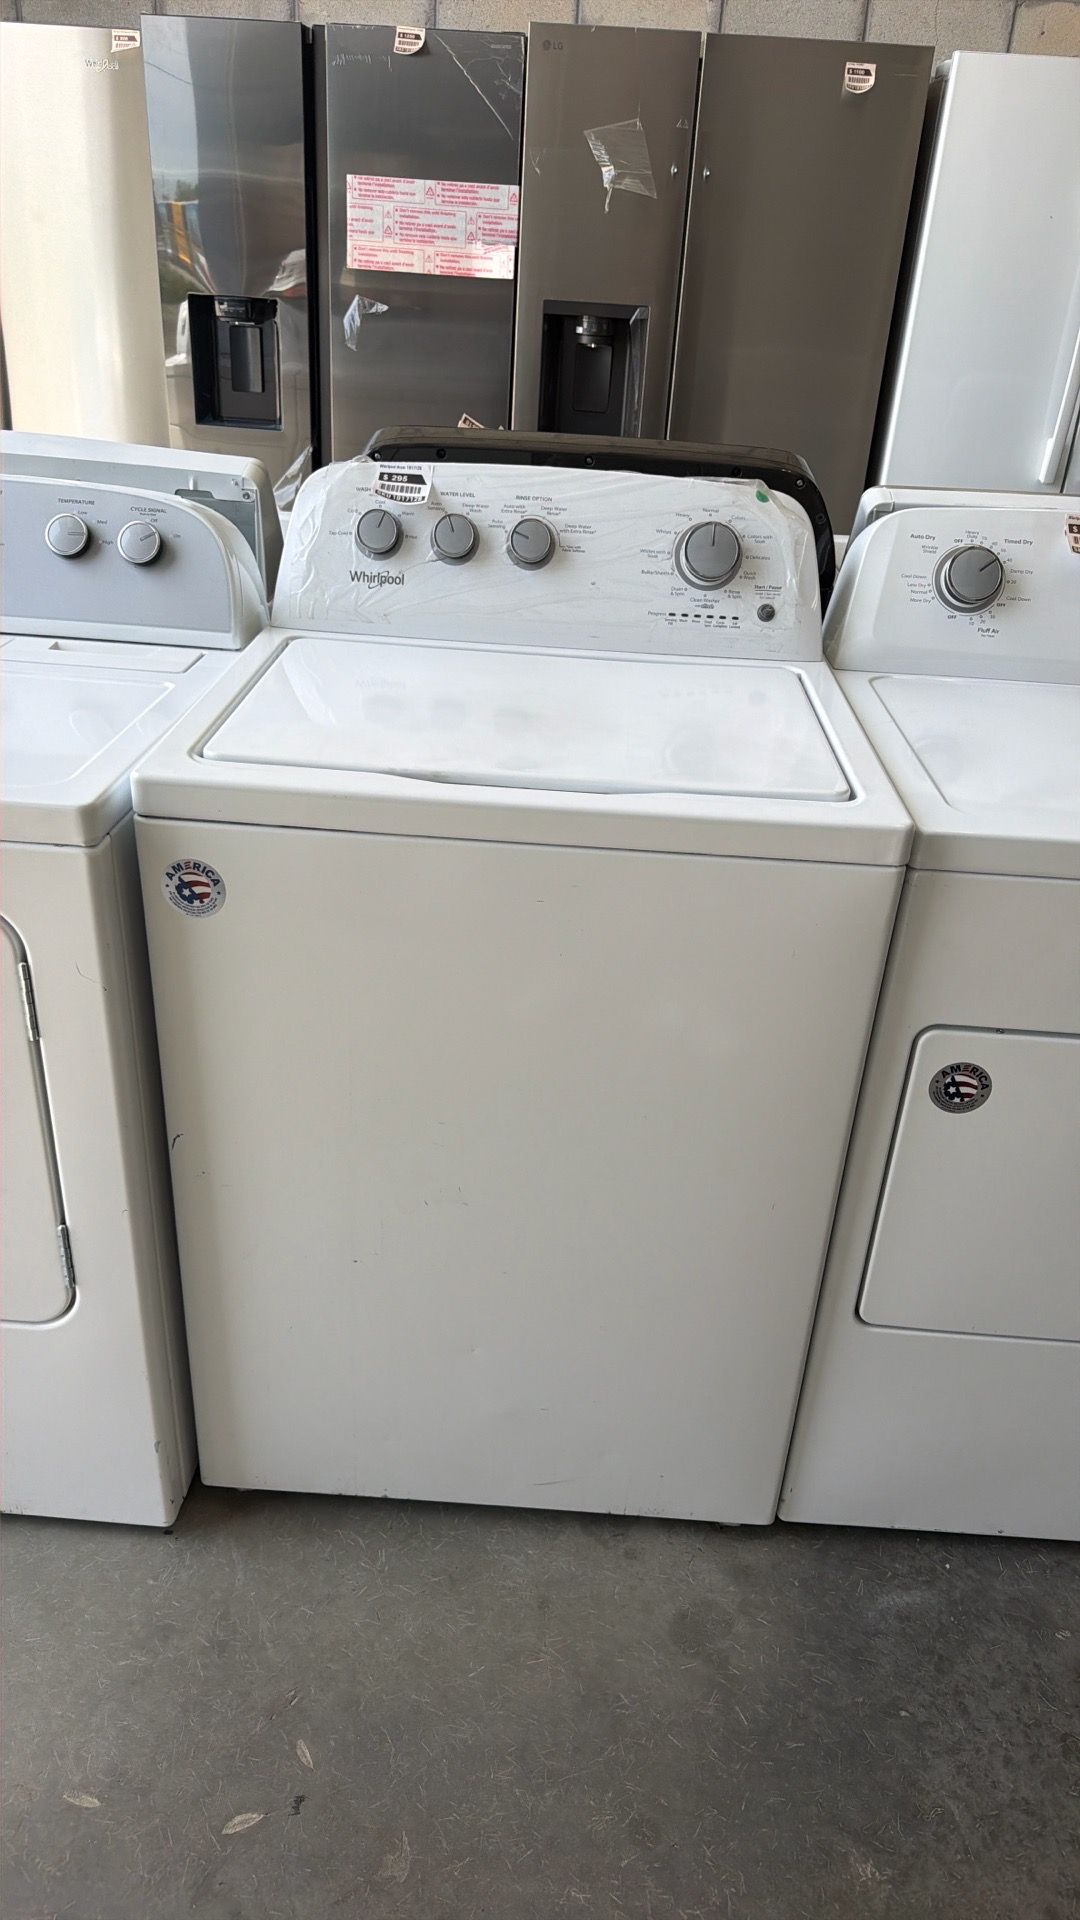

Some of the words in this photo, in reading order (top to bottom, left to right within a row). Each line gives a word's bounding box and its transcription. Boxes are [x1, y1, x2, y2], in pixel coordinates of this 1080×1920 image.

[349, 570, 404, 589] Whirlpool
[165, 861, 220, 886] AMERICA
[941, 1065, 989, 1090] AMERICA
